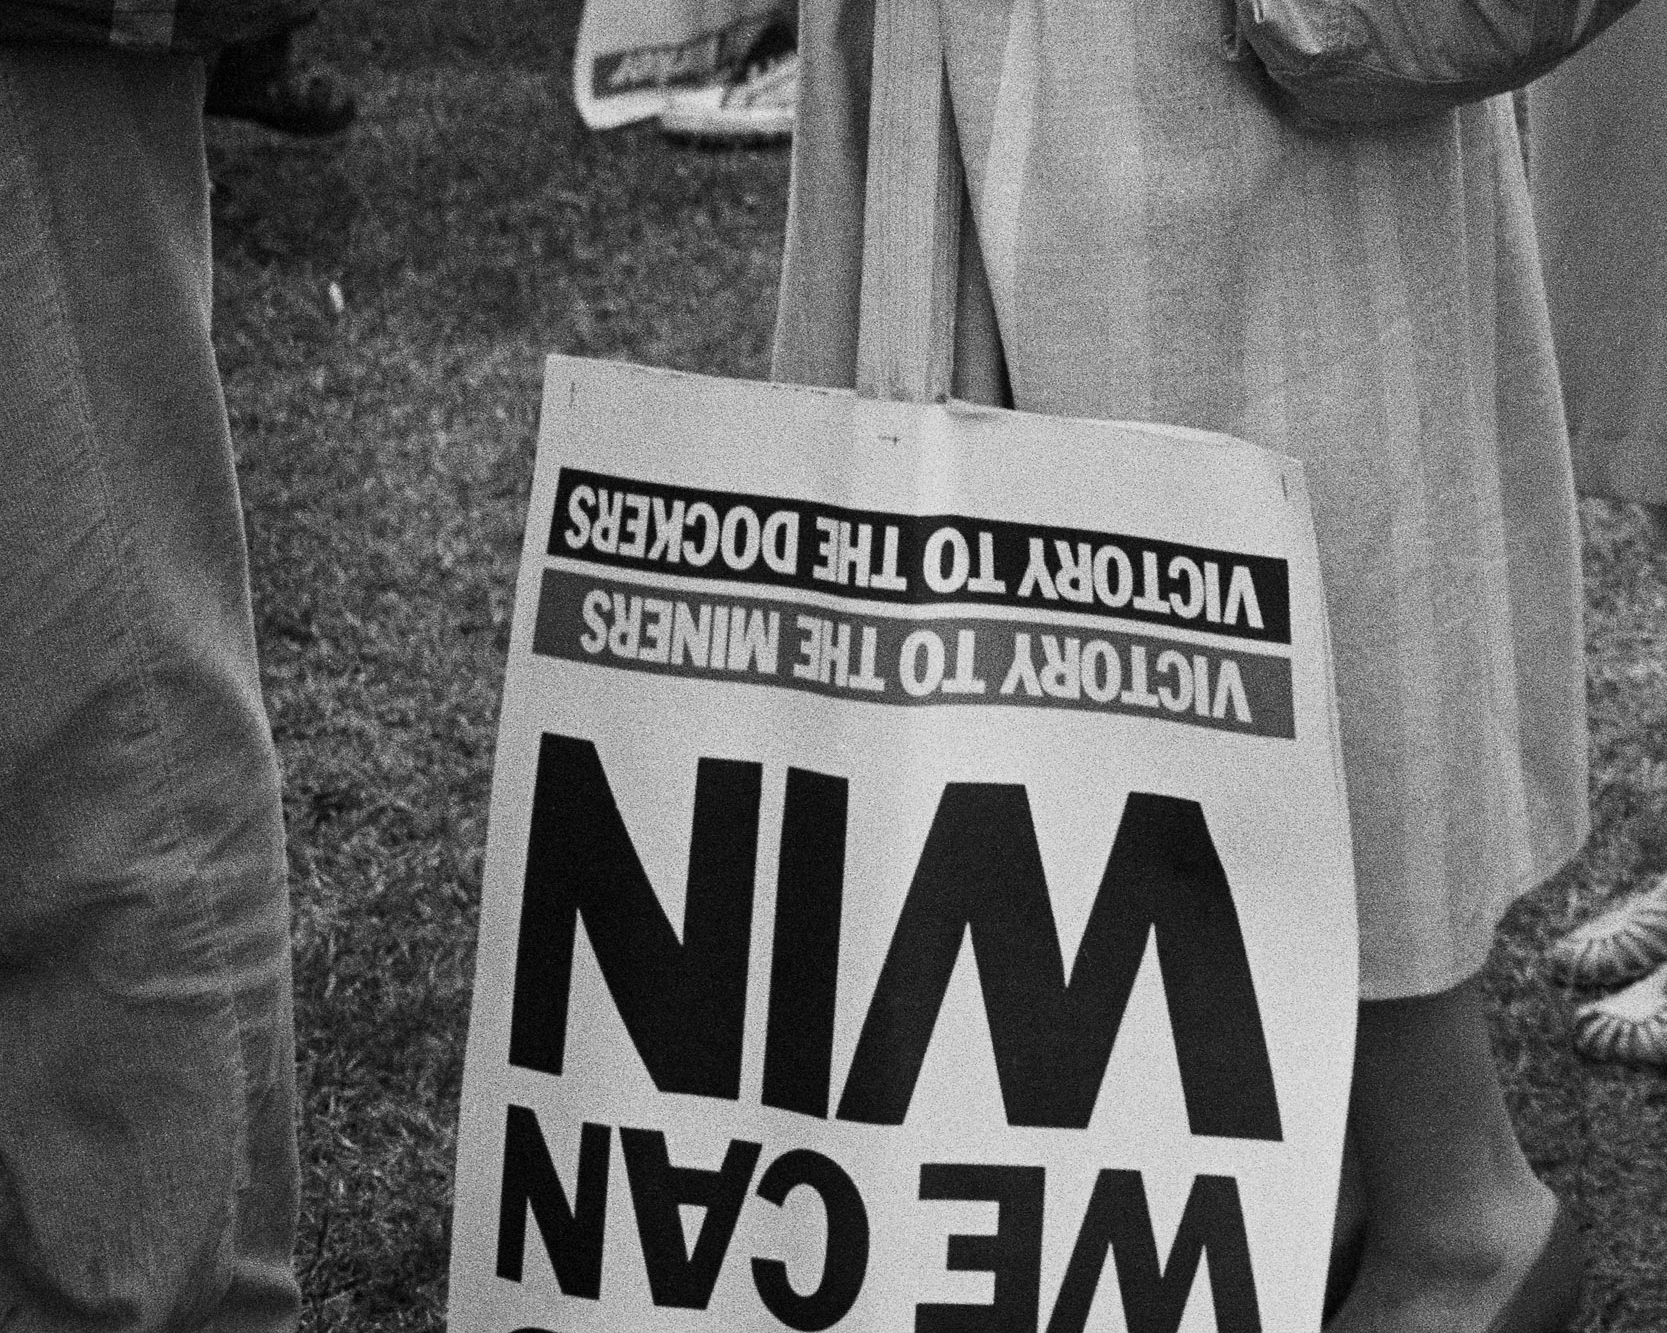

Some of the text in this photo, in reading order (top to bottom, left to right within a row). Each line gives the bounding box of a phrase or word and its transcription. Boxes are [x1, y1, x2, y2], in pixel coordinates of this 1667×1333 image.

[565, 485, 1266, 629] VICTORY TO THE DOCKERS
[579, 590, 1254, 724] VICTORY TO THE MINERS
[508, 731, 1285, 1143] WIN
[495, 1103, 1264, 1333] WE CAN
